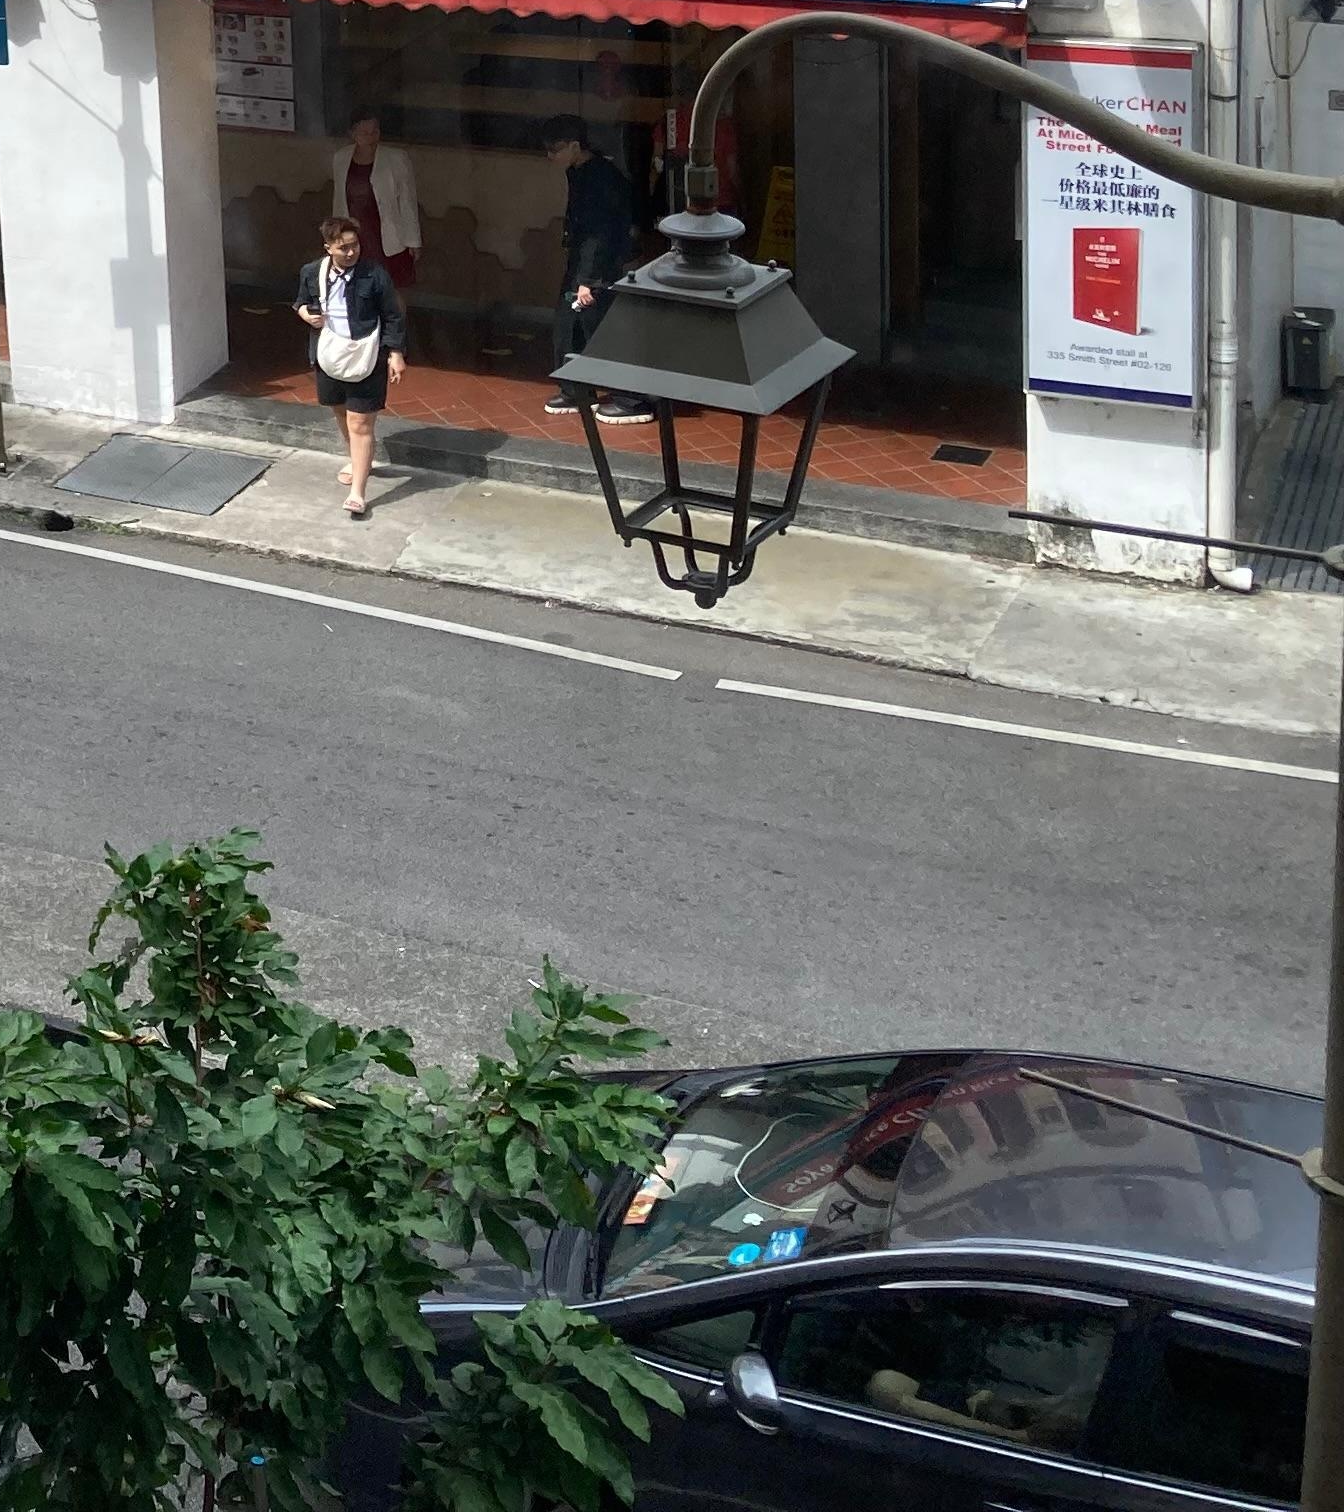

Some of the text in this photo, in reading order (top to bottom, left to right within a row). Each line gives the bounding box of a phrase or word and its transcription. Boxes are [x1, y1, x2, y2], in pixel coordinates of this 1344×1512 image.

[1092, 95, 1187, 114] kerCHAN
[1037, 128, 1053, 139] At
[1145, 124, 1182, 136] Meal
[1046, 140, 1092, 153] Street
[1075, 162, 1144, 181] 全球史上
[1058, 178, 1160, 201] 价格最低廉的
[1041, 195, 1177, 219] 一星级米其林膳食
[1070, 343, 1113, 355] Awarded
[1115, 348, 1136, 357] stall
[1068, 352, 1096, 364] Smith
[1098, 356, 1129, 367] Street
